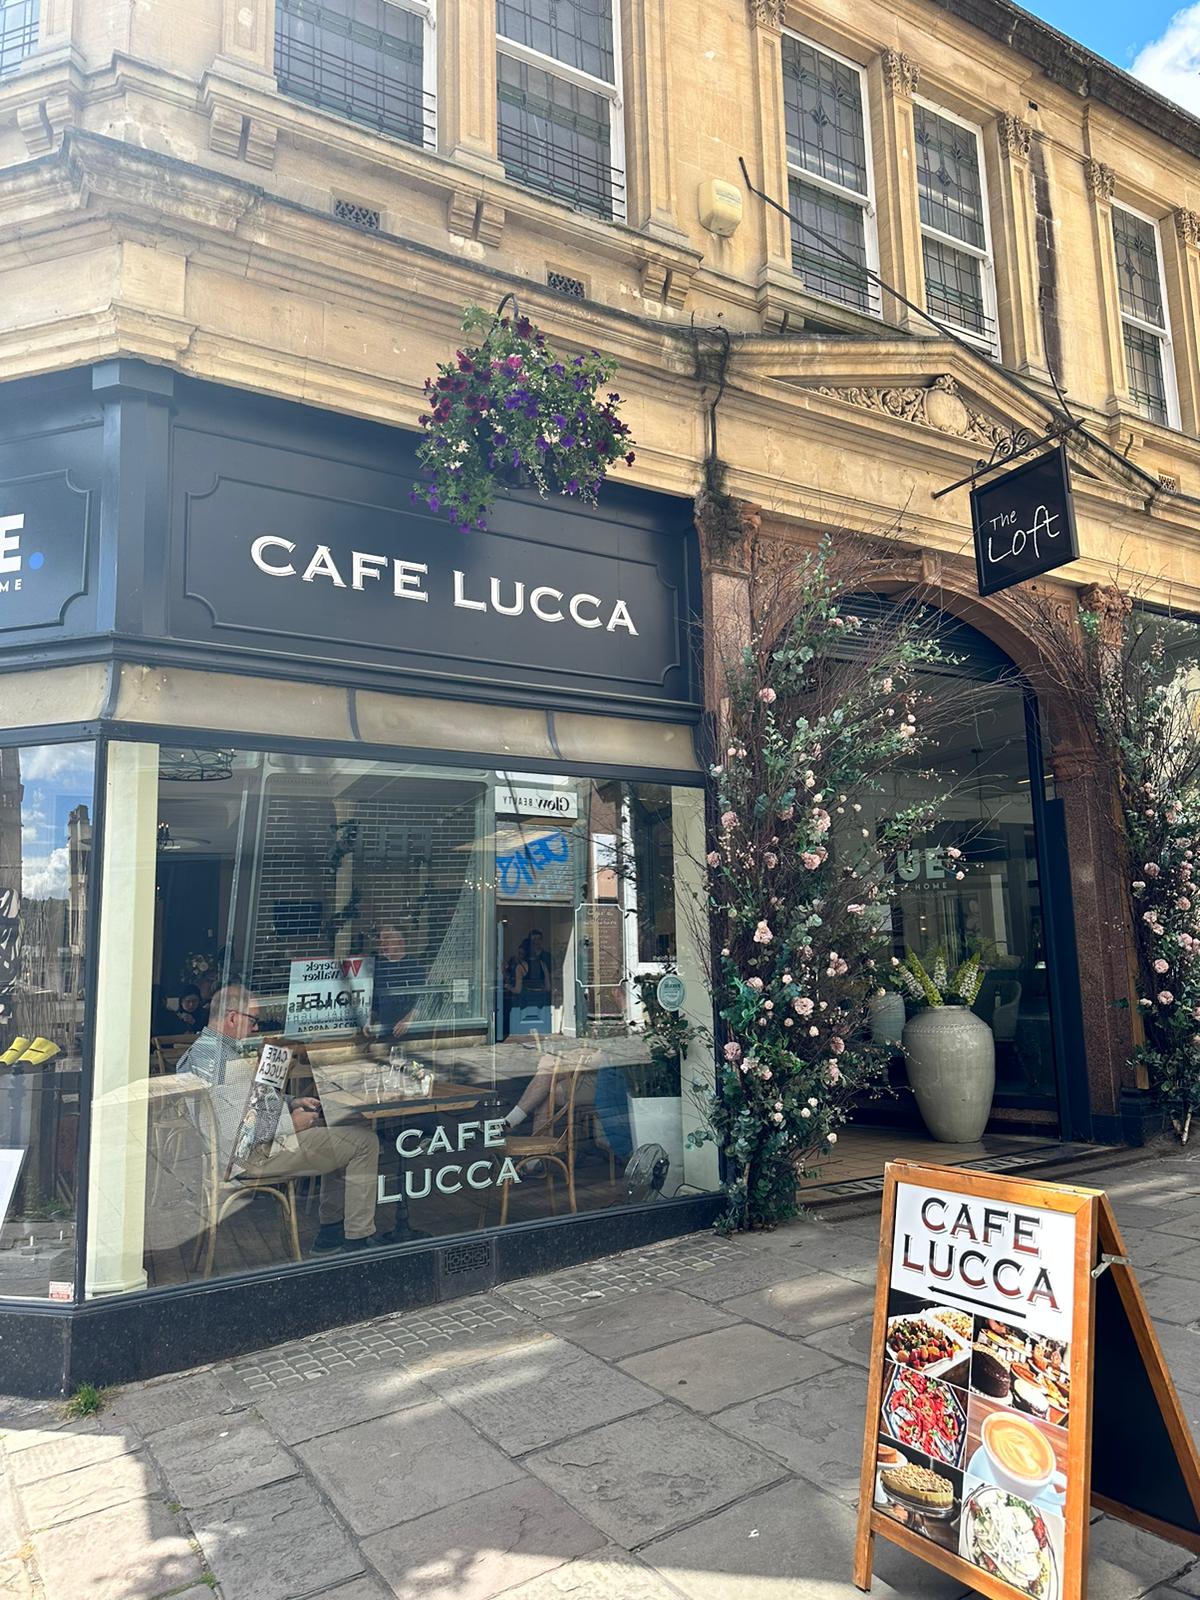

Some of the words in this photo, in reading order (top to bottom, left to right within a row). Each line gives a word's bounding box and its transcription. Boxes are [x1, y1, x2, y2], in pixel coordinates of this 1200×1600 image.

[988, 505, 1061, 563] Loft
[989, 510, 1018, 531] The
[250, 535, 429, 603] CAFE
[453, 570, 639, 636] LUCCA
[395, 1118, 507, 1159] CAFE
[377, 1157, 522, 1204] LUCCA
[921, 1197, 1043, 1258] CAFE
[902, 1234, 1062, 1313] LUCCA
